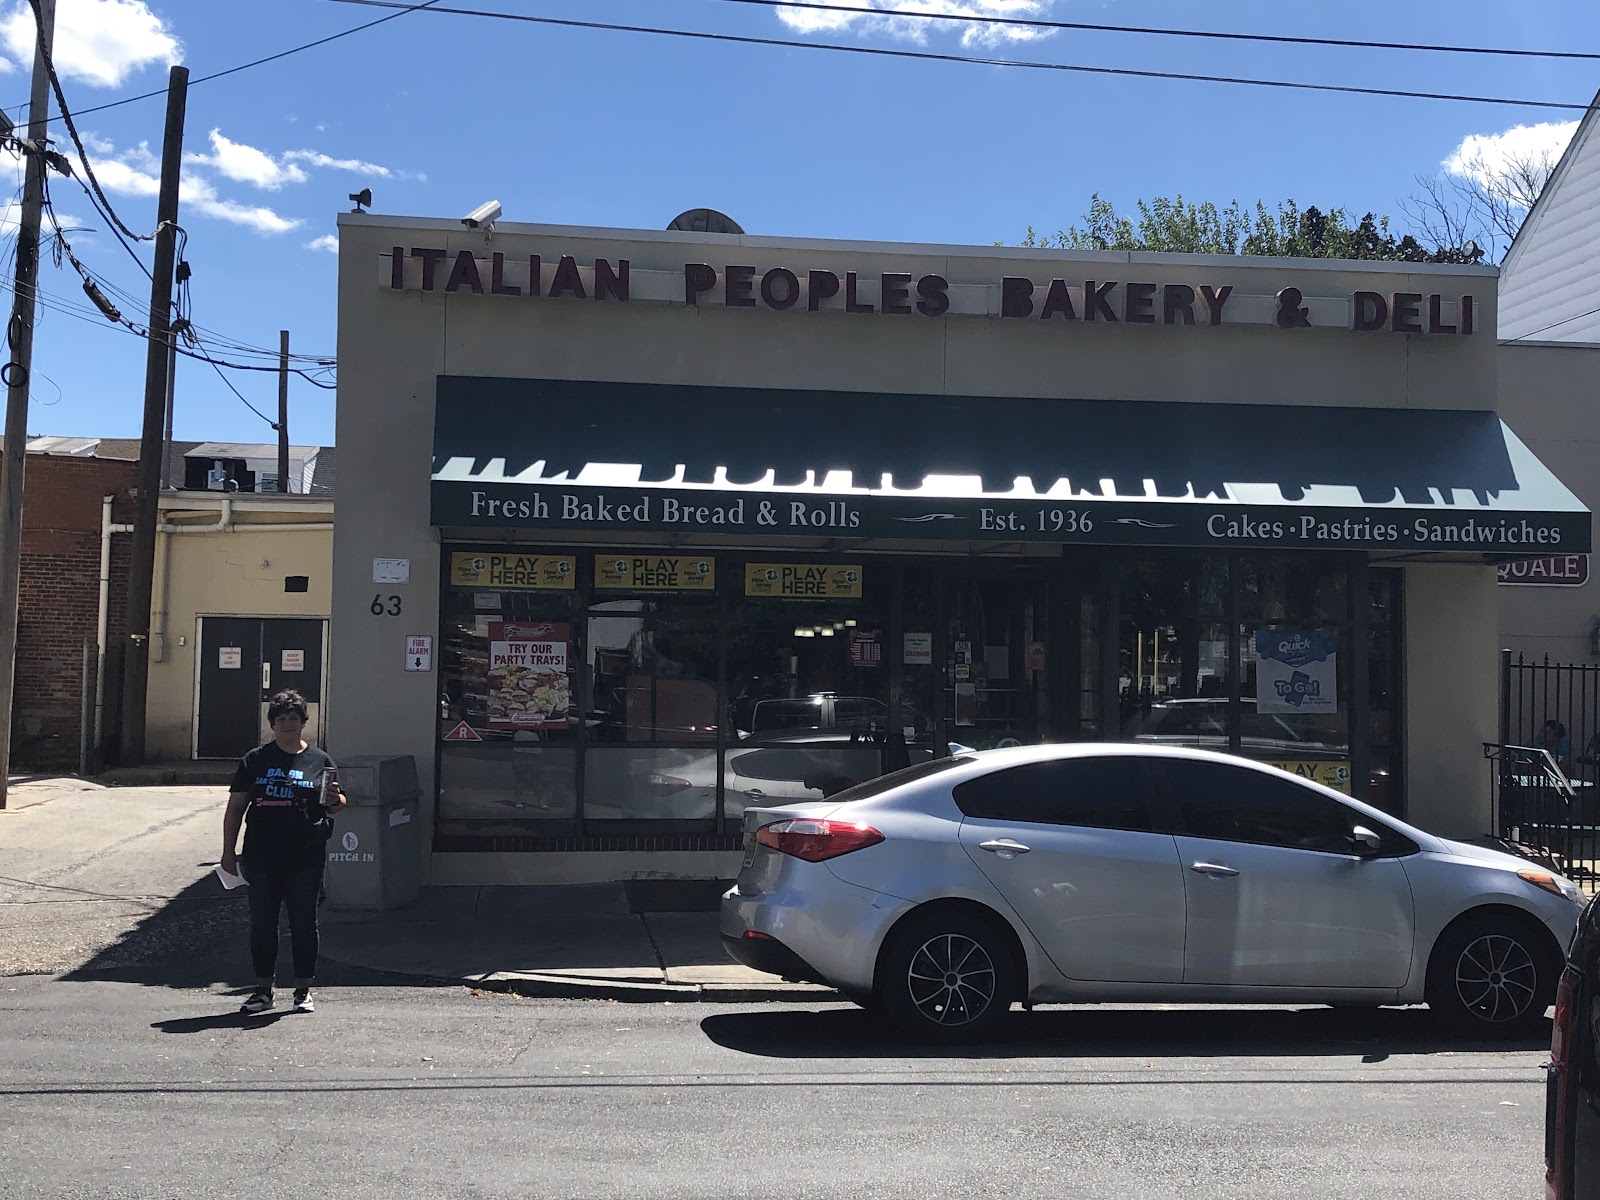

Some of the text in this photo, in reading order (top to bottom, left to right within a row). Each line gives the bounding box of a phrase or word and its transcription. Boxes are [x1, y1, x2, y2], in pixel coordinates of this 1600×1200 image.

[391, 245, 1474, 335] ITALIAN PEOPLES BAKERY & DELI
[470, 491, 861, 529] Fresh Baked Bread & Rolls
[979, 507, 1093, 534] Est. 1936
[1207, 513, 1562, 546] Cakes Pastries Sandwiches
[490, 556, 539, 571] PLAY
[632, 558, 679, 573] PLAY
[490, 571, 538, 585] HERE
[632, 572, 678, 586] HERE
[782, 567, 828, 581] PLAY
[782, 581, 827, 594] HERE
[371, 594, 402, 617] 63
[412, 639, 426, 647] FIRE
[508, 643, 553, 654] TRY OUR
[1278, 638, 1312, 654] Quick
[408, 647, 429, 655] ALARM
[494, 655, 565, 665] PARTY TRAYS!
[1276, 681, 1318, 694] To Go!
[459, 727, 468, 738] R
[266, 784, 295, 798] CLUB
[328, 852, 374, 862] PITCH IN
